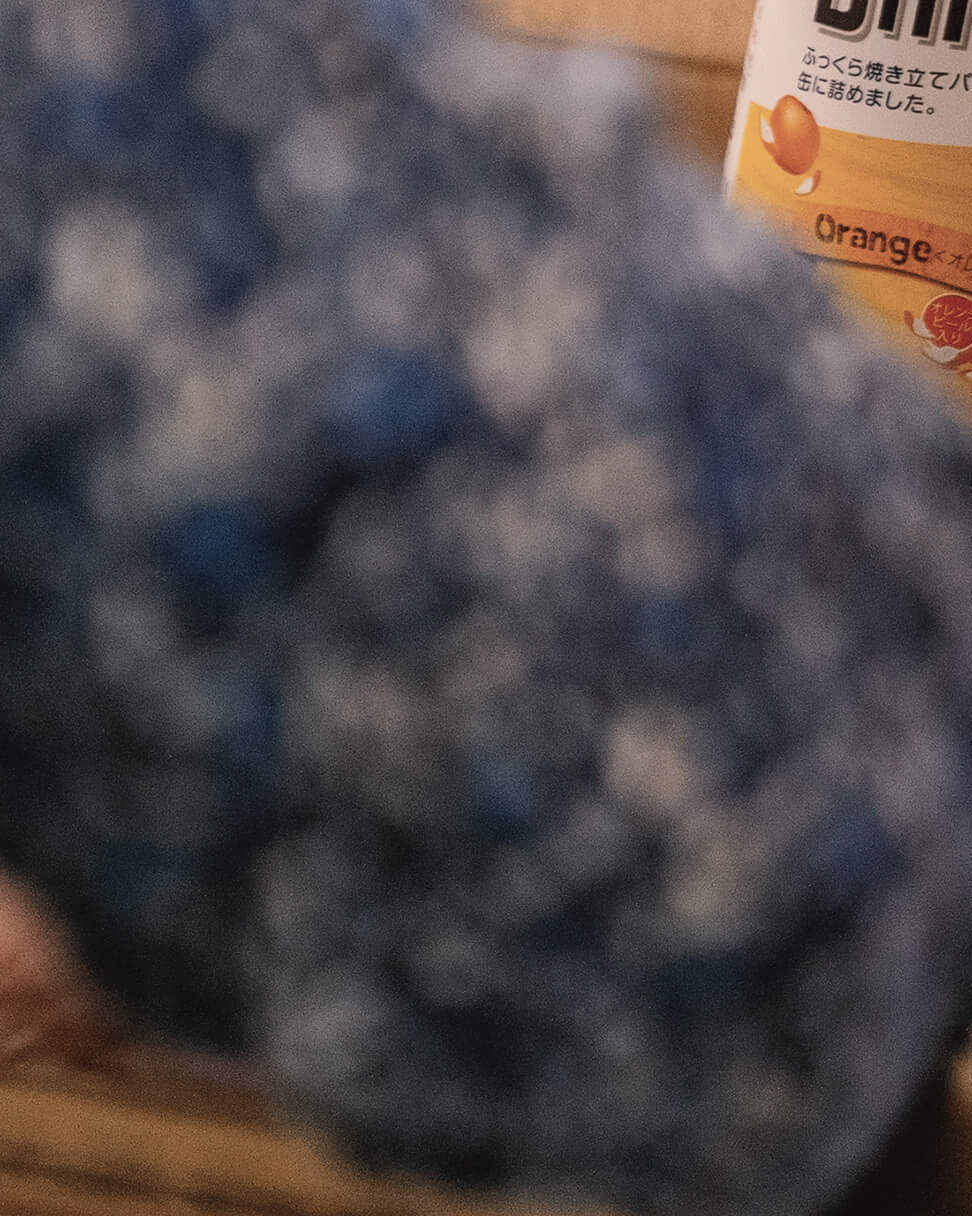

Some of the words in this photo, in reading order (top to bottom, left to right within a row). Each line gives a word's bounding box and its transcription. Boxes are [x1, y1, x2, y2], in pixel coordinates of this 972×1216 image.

[797, 71, 936, 116] 缶に詰めました。
[815, 213, 932, 265] Orange
